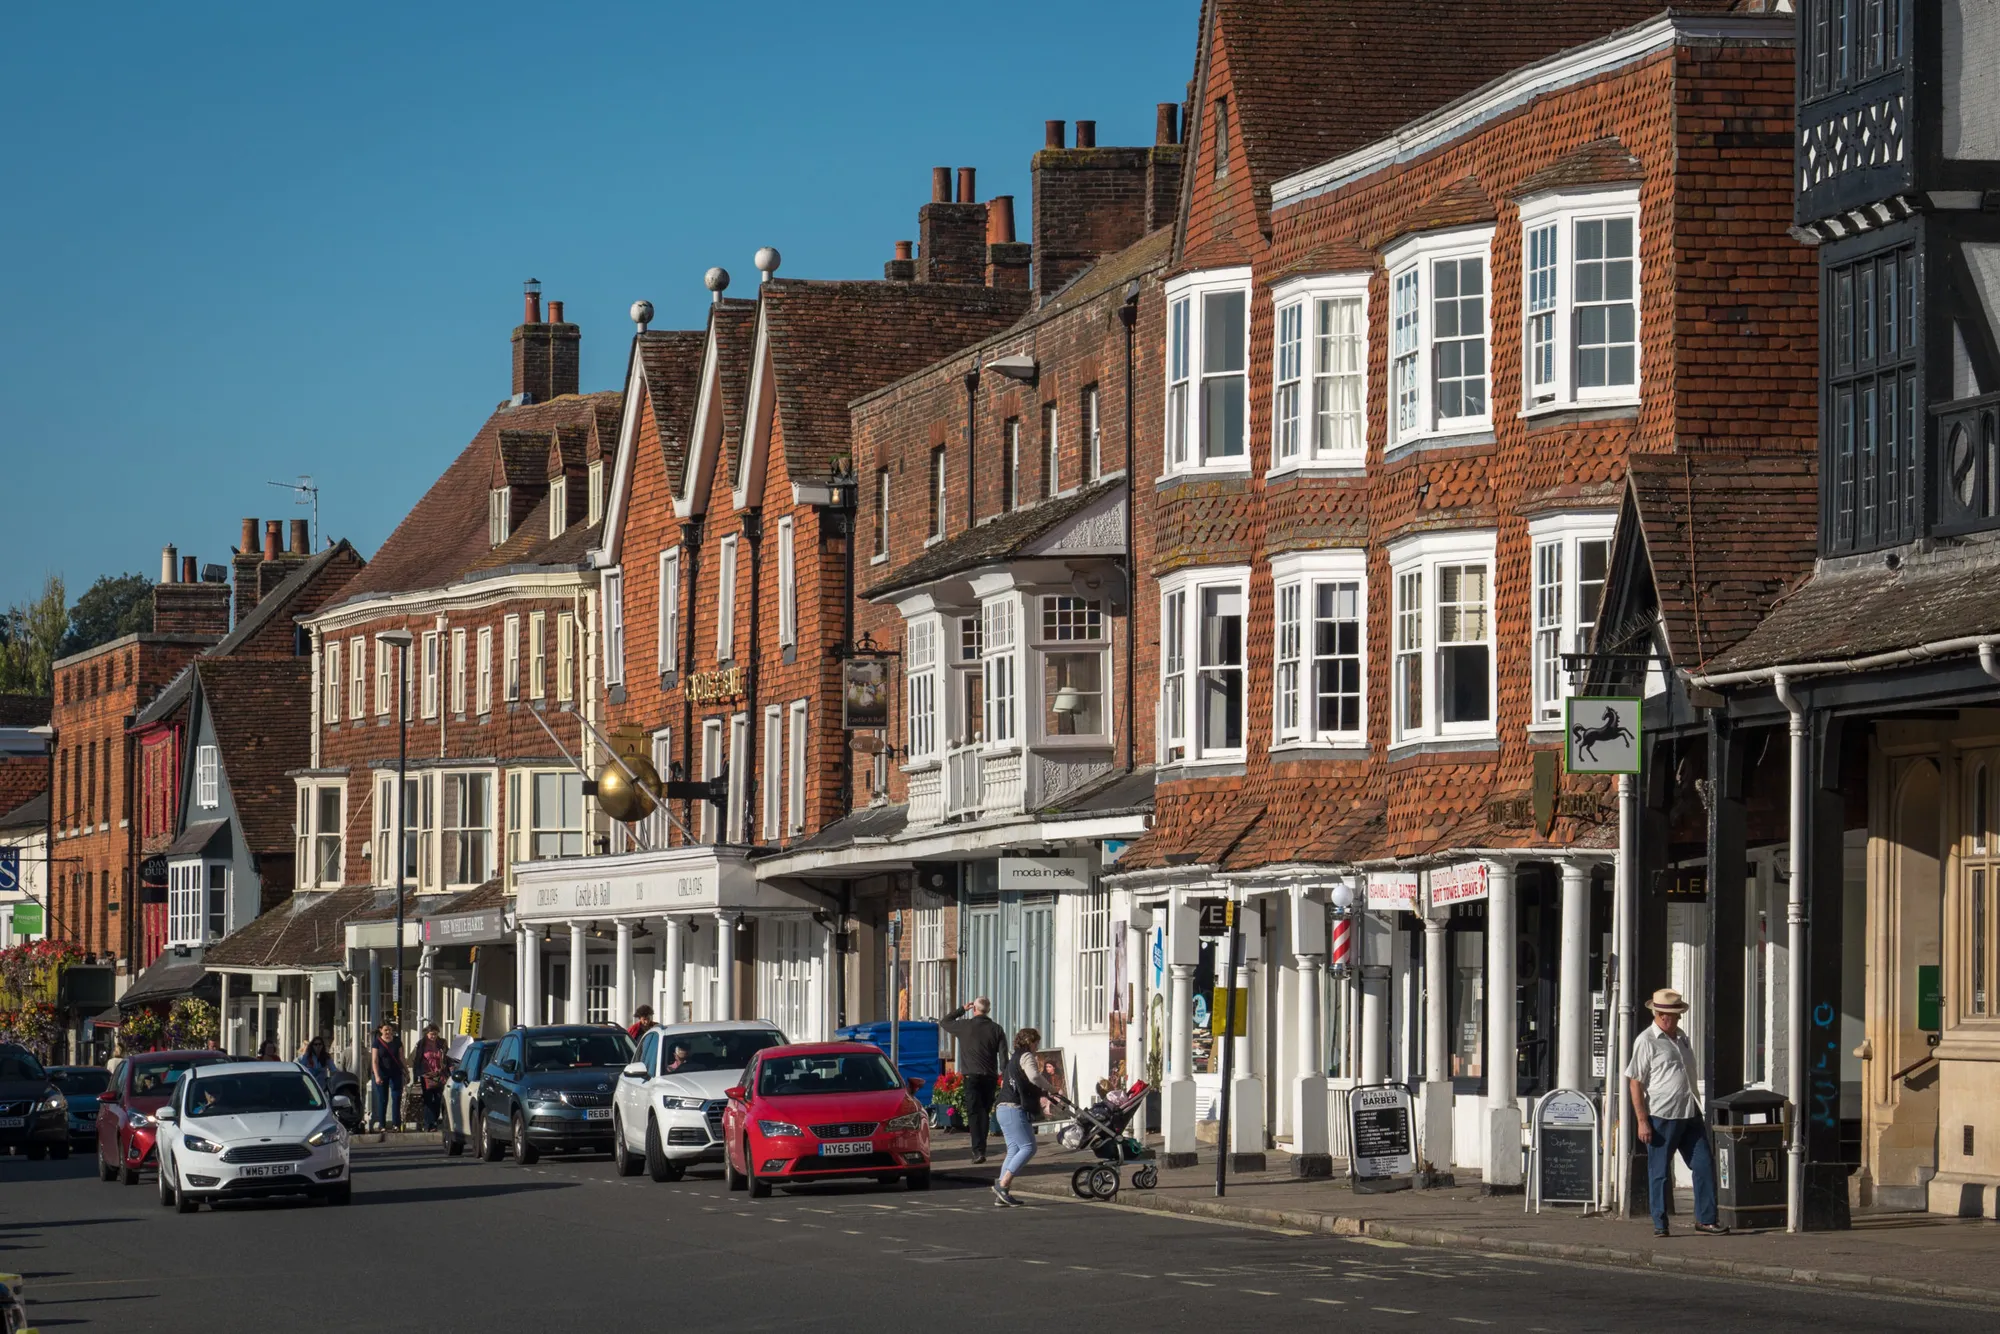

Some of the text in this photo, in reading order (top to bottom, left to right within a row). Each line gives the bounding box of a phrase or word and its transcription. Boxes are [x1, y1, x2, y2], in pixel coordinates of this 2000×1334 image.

[145, 867, 168, 877] DUD
[1012, 867, 1076, 879] moda in pelle
[1432, 865, 1477, 887] TRADITIONAL TURKISH
[576, 882, 591, 907] Castle
[600, 881, 610, 906] Ball
[1369, 883, 1418, 899] ISTANBUL BARBER
[1433, 882, 1479, 903] HOT TOWEL SHAVE
[440, 920, 450, 935] THE
[450, 917, 467, 933] WHITE
[467, 916, 485, 931] HARTE
[1362, 1096, 1398, 1106] BARBER
[588, 1110, 610, 1119] RE68
[825, 1142, 872, 1154] HY65 GHG
[246, 1165, 290, 1176] WM67 EEP
